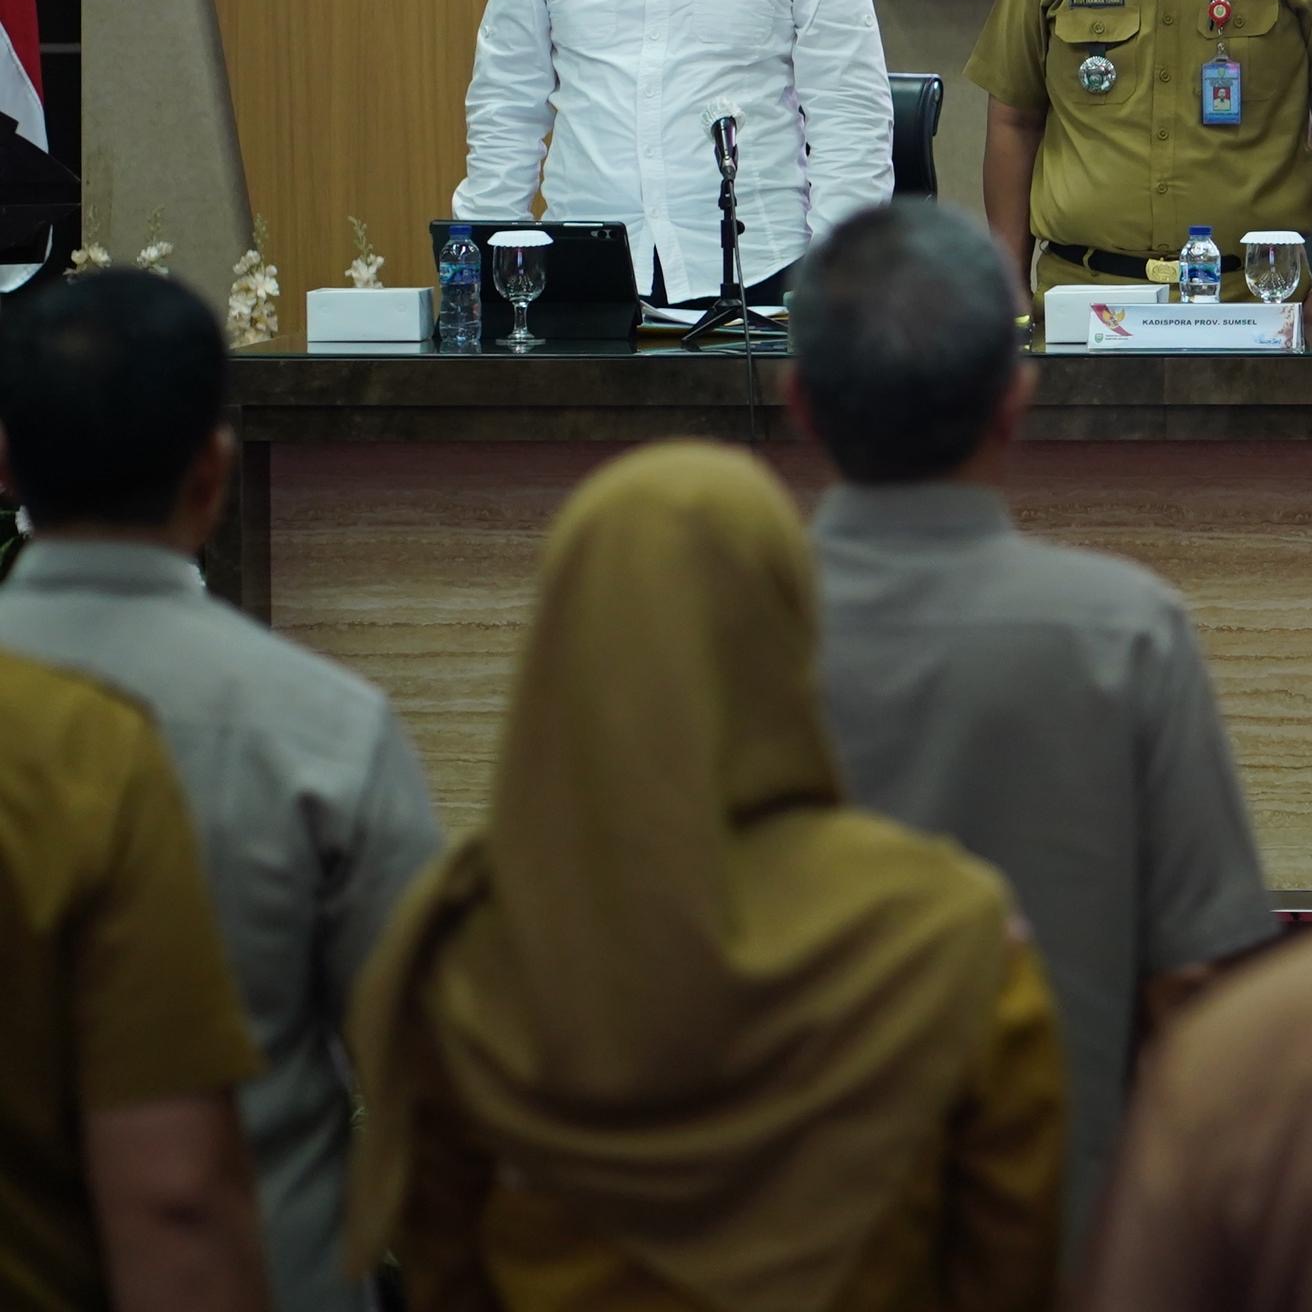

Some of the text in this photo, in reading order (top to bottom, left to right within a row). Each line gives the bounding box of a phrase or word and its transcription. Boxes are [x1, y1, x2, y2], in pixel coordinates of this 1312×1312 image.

[1142, 318, 1258, 327] KADISPORA PROV. SUMSEL
